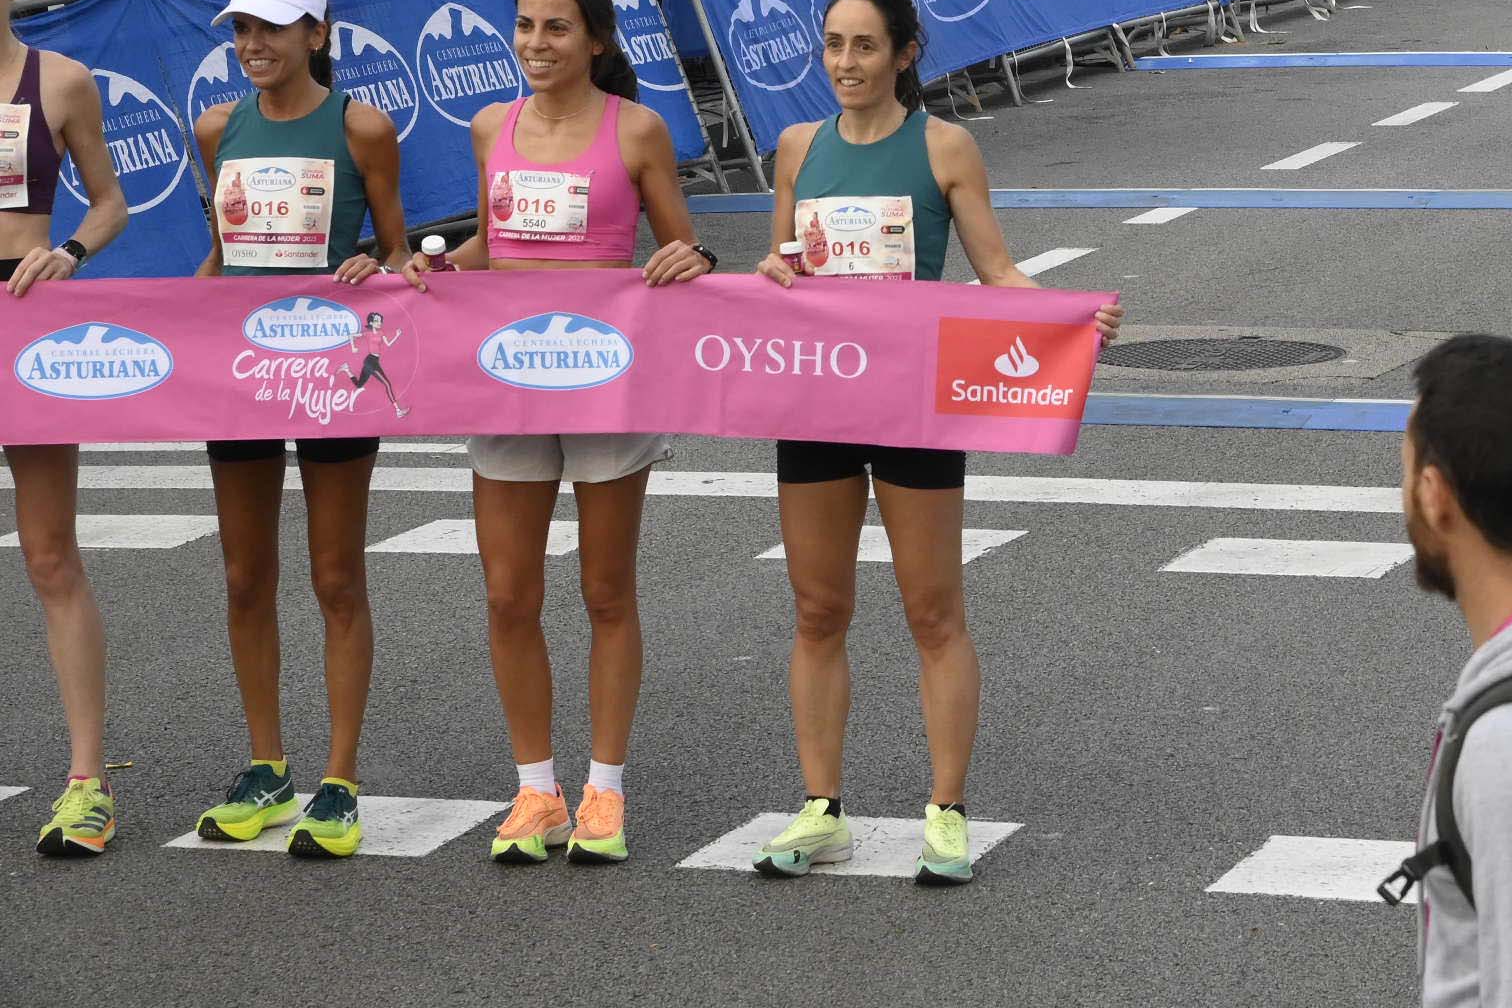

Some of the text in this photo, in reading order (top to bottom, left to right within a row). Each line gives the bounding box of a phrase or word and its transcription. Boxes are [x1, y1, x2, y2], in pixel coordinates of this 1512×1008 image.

[624, 15, 658, 32] CENTRAL
[436, 41, 503, 62] CENTRAL LECHERA
[615, 23, 674, 65] ASTUR
[335, 58, 400, 82] NTRAL LECHERA
[430, 53, 518, 103] ASTURIANA
[120, 108, 161, 130] LECHERA
[251, 200, 290, 216] 016
[516, 198, 556, 215] 016
[265, 221, 272, 231] 5
[522, 218, 547, 229] 5540
[831, 240, 871, 257] 016
[848, 261, 855, 271] 6
[251, 318, 352, 340] ASTURIANA
[26, 351, 161, 381] ASTURIANA
[231, 349, 331, 382] Carrera
[490, 342, 622, 371] ASTURIANA
[694, 334, 869, 380] OYSHO
[255, 373, 365, 425] de la Mujer
[951, 378, 1074, 409] Santander
